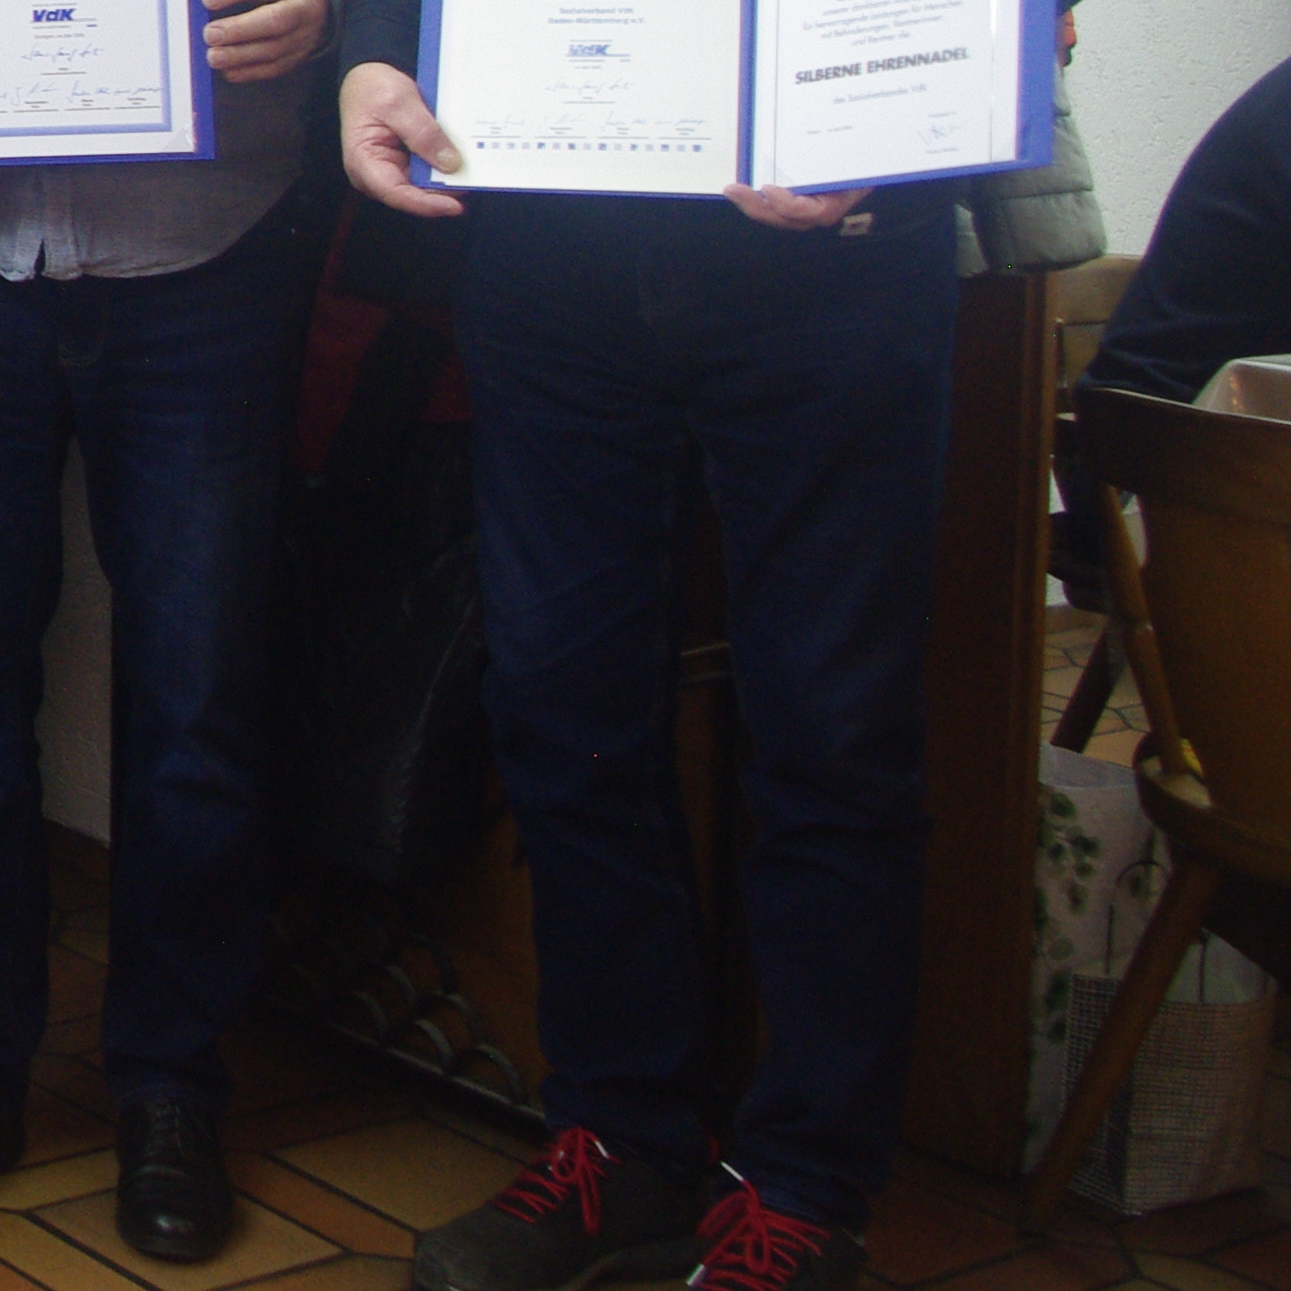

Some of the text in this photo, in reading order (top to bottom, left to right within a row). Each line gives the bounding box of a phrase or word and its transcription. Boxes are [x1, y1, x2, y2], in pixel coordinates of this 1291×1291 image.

[33, 8, 76, 22] VdK
[795, 47, 970, 85] SILBERNE EHRENNADEL
